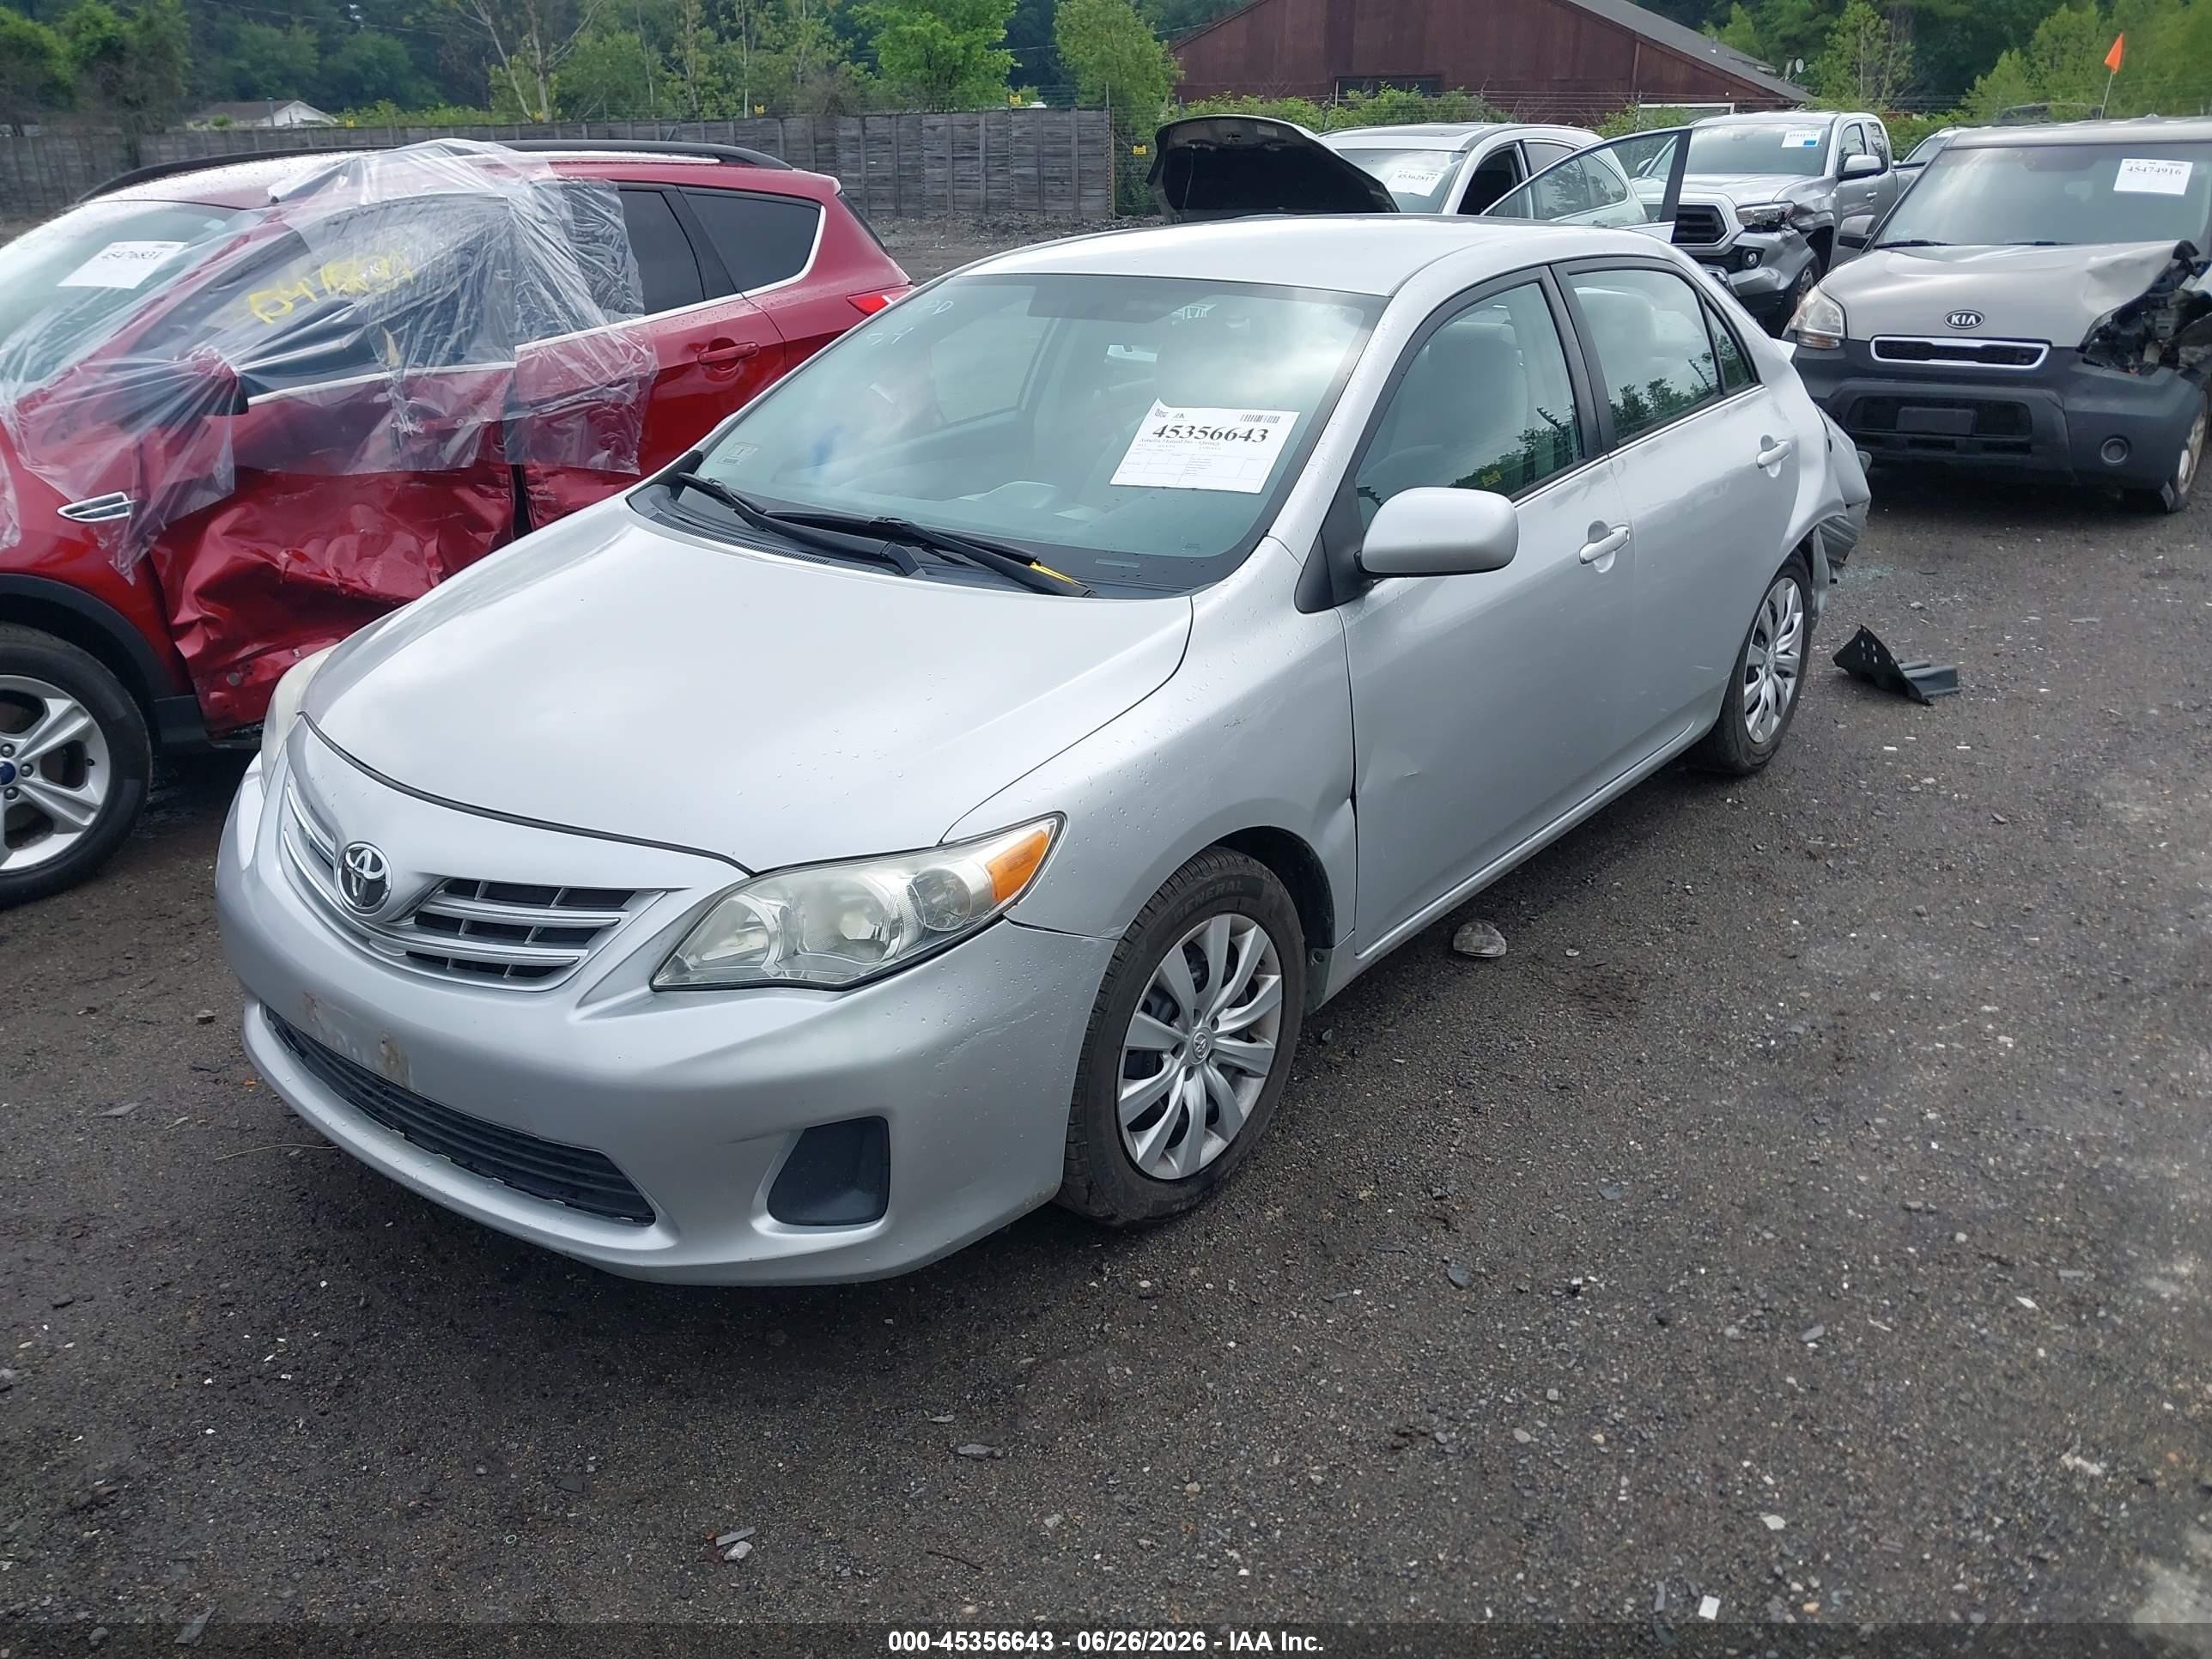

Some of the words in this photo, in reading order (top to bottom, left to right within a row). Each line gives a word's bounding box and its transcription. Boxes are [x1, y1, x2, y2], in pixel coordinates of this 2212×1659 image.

[2125, 165, 2182, 175] 45474916
[1951, 314, 1977, 325] KIA
[1152, 423, 1269, 444] 45356643
